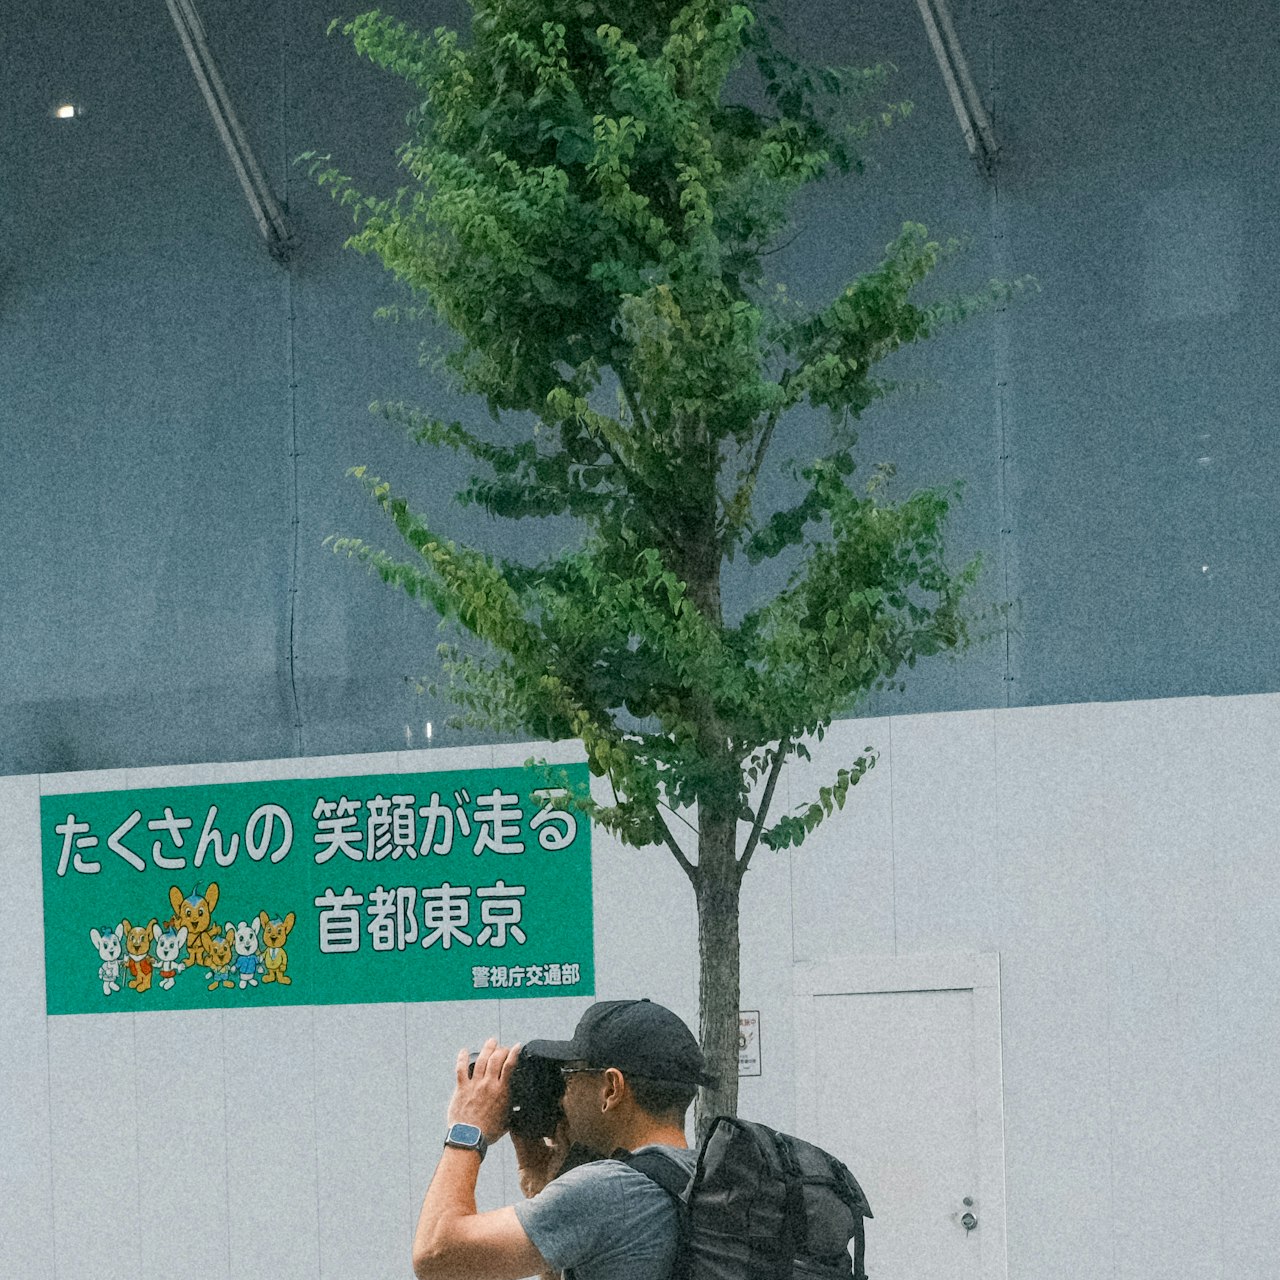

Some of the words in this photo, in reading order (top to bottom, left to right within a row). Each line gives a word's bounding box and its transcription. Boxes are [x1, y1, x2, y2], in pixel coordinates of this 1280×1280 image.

[55, 803, 294, 878] たくさんの
[311, 787, 578, 865] 笑顔が走る
[313, 879, 528, 954] 首都東京
[471, 963, 582, 989] 警視庁交通部
